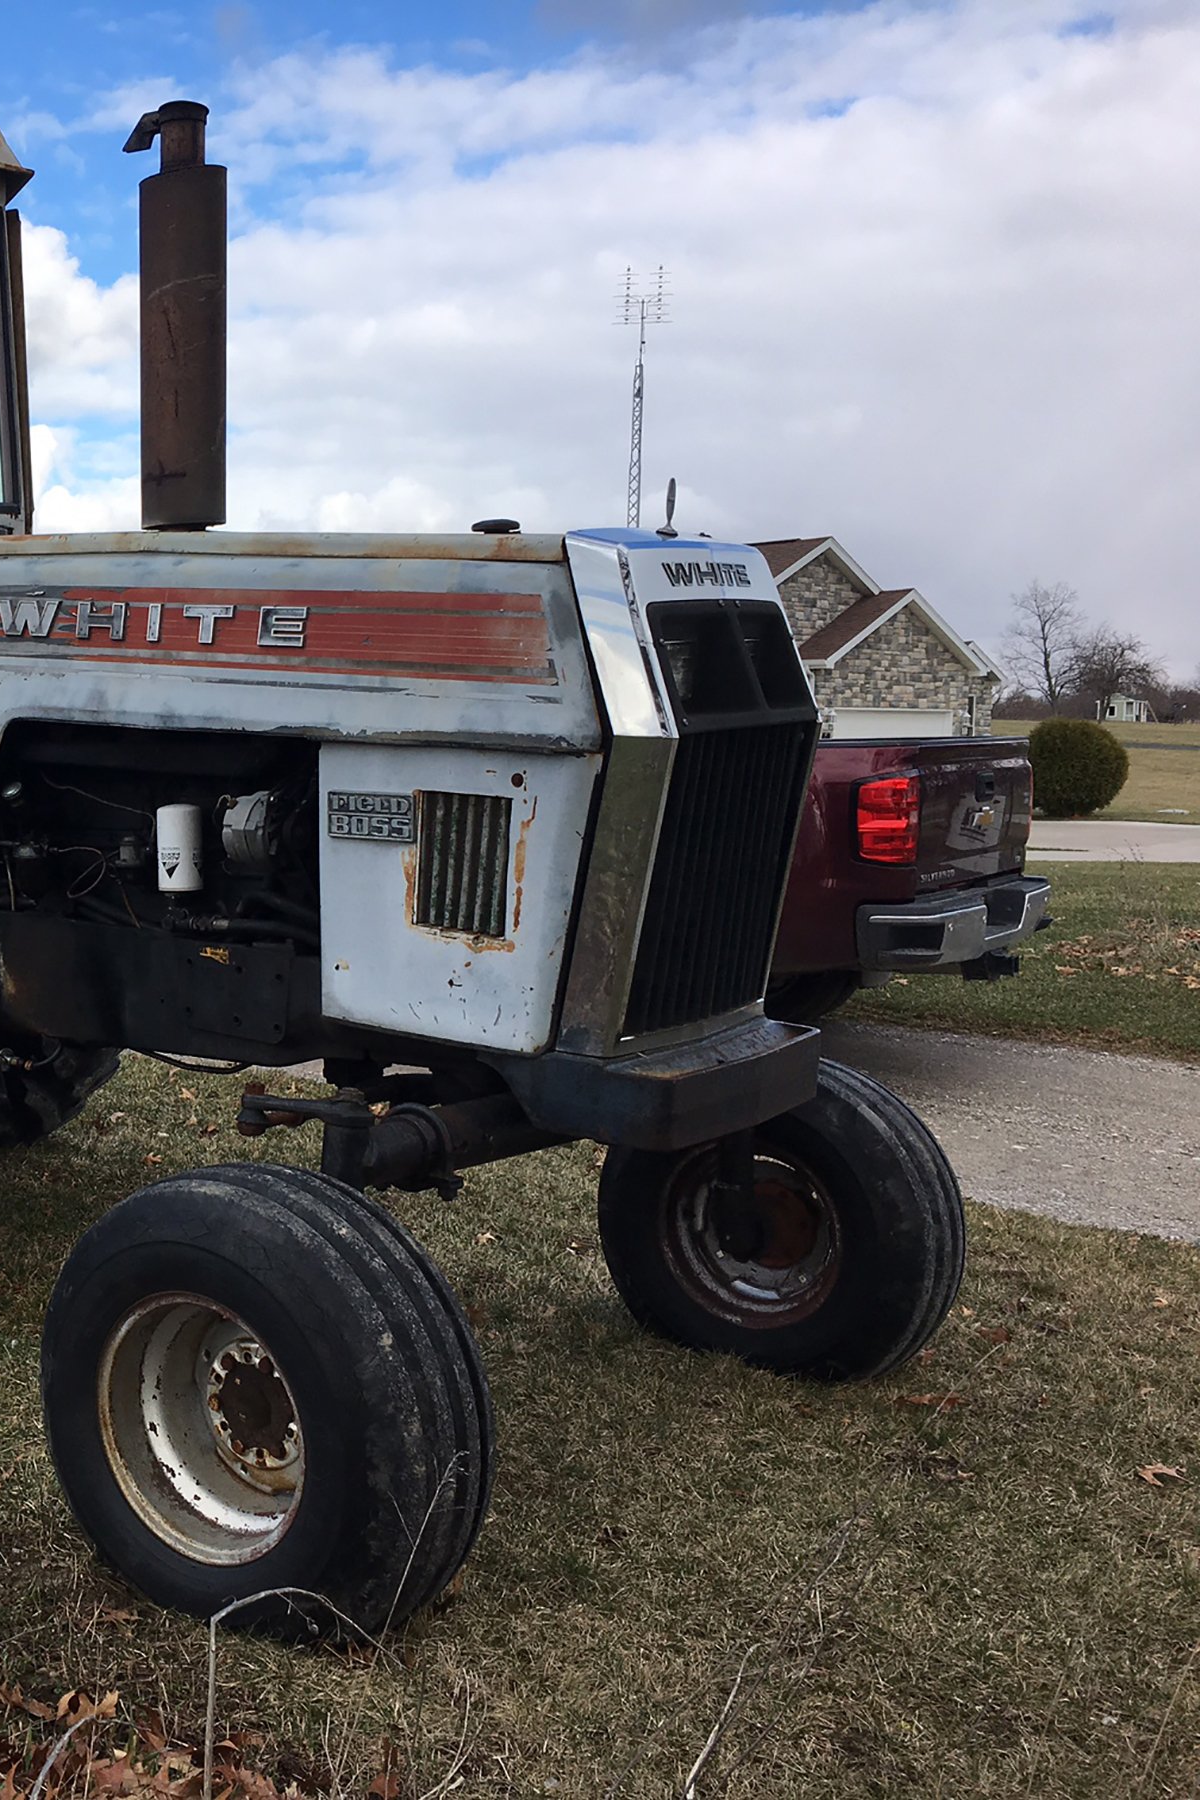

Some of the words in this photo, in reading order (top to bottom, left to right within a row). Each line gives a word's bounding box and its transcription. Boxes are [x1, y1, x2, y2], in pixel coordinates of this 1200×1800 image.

[661, 561, 751, 588] WHITE
[330, 794, 410, 814] FIELD
[330, 814, 410, 838] BOSS
